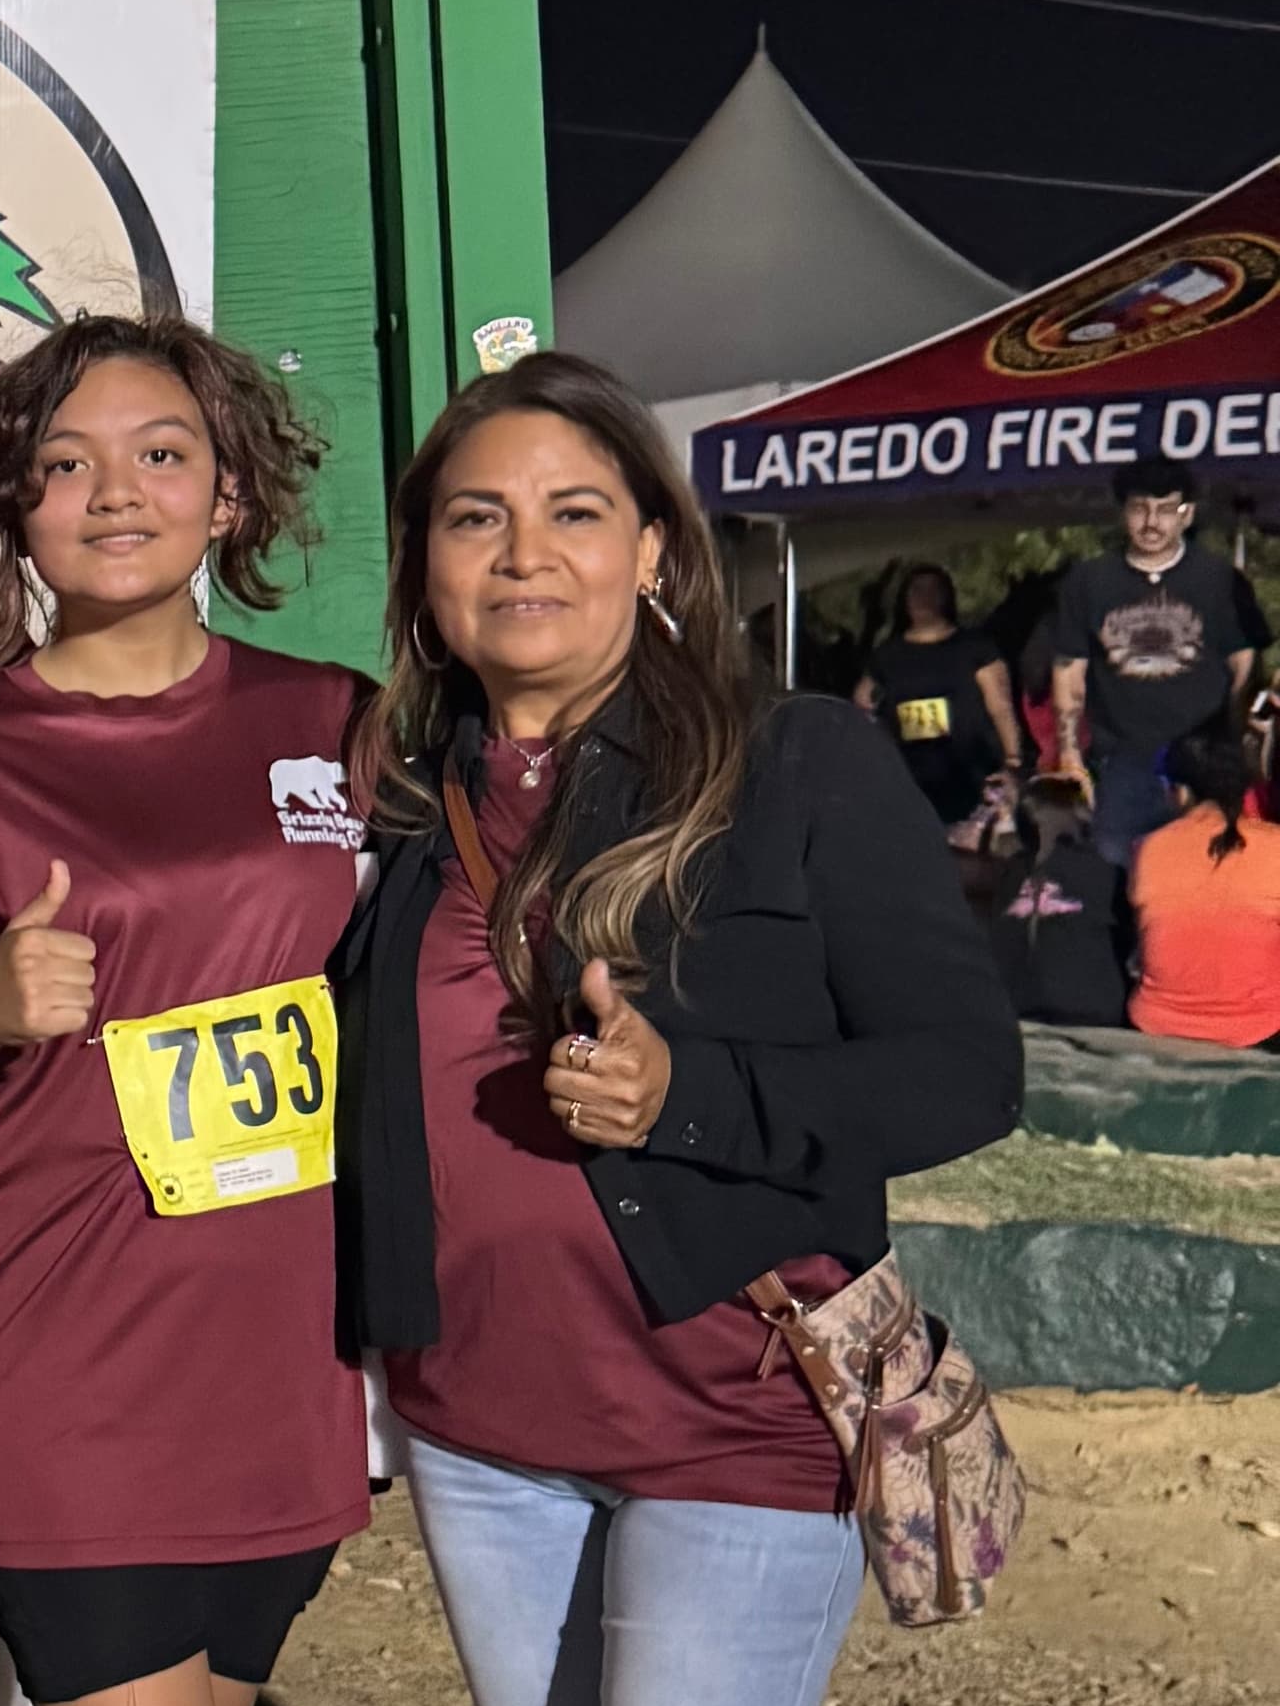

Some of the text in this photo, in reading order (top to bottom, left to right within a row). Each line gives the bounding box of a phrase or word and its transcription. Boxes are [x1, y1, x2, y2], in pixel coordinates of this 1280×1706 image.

[720, 416, 969, 493] LAREDO
[986, 402, 1144, 471] FIRE
[147, 1003, 324, 1142] 753
